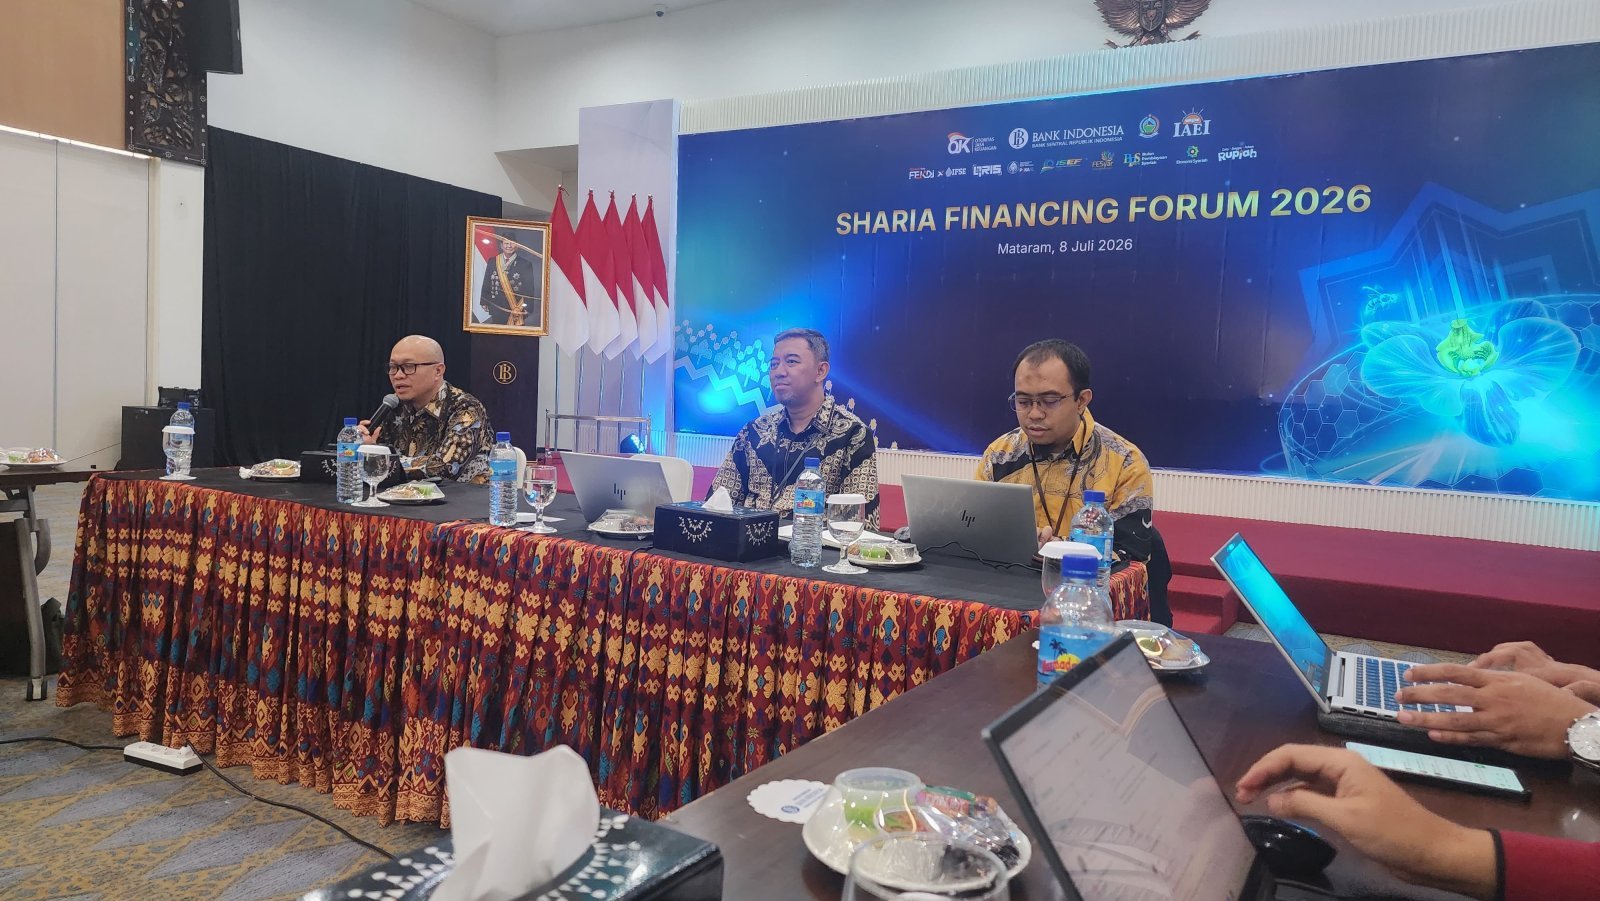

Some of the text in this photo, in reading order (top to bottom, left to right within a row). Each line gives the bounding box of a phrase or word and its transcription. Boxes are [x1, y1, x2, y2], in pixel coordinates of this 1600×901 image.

[1032, 125, 1125, 142] BANK INDONESIA
[1173, 119, 1211, 138] IAEI
[1068, 138, 1094, 146] REPUBLIK
[1094, 136, 1123, 144] INDONESIA
[836, 184, 1372, 236] SHARIA FINANCING FORUM 2026
[997, 238, 1133, 256] Mataram, 8 Juli 2026
